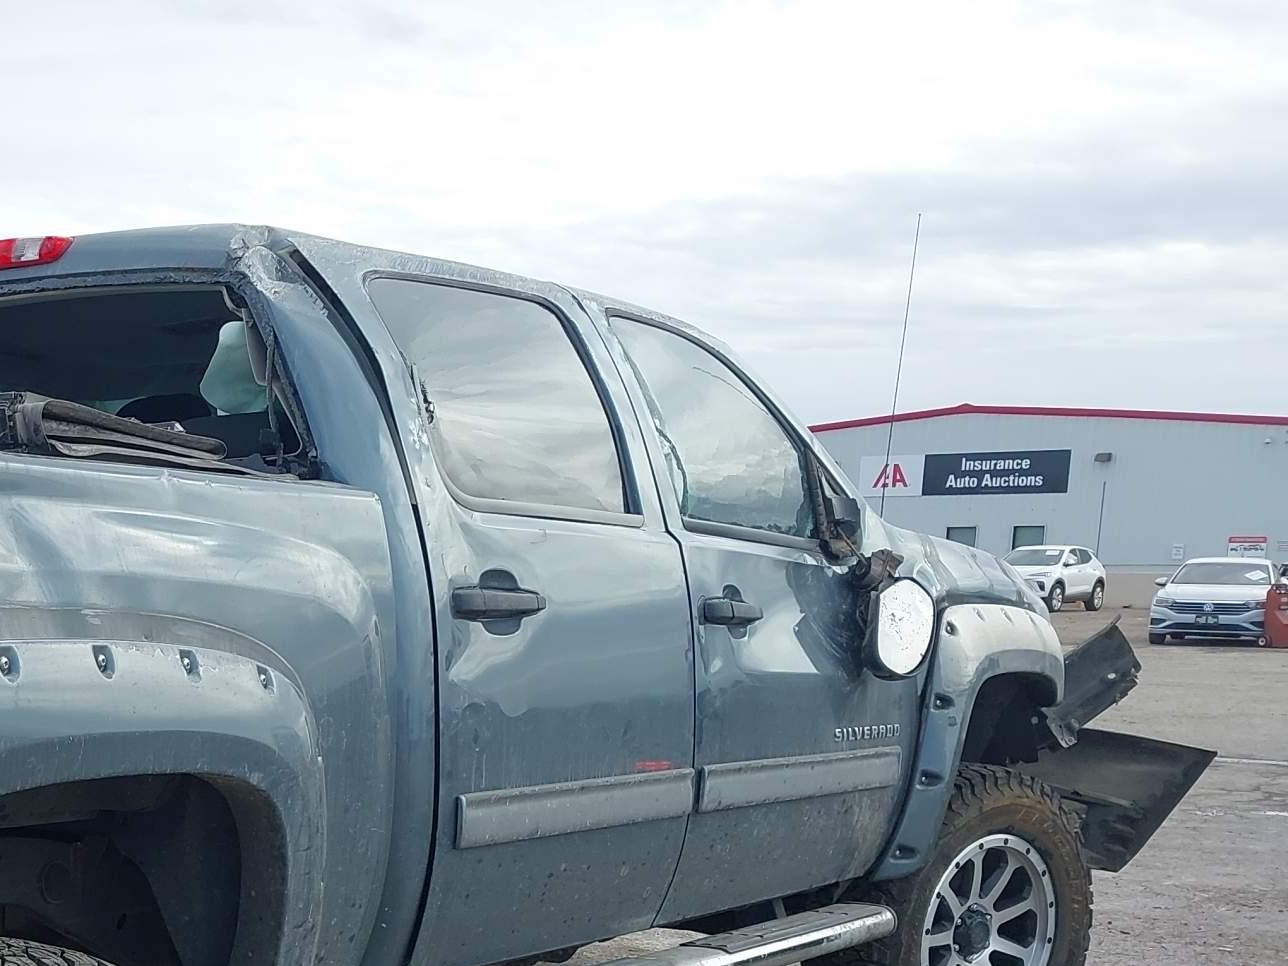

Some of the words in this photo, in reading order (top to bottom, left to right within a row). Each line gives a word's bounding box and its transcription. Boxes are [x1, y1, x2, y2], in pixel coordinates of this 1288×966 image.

[962, 457, 1030, 471] Insurance
[945, 475, 978, 488] Auto
[981, 473, 1044, 488] Auctions
[834, 723, 901, 742] SILVERADO
